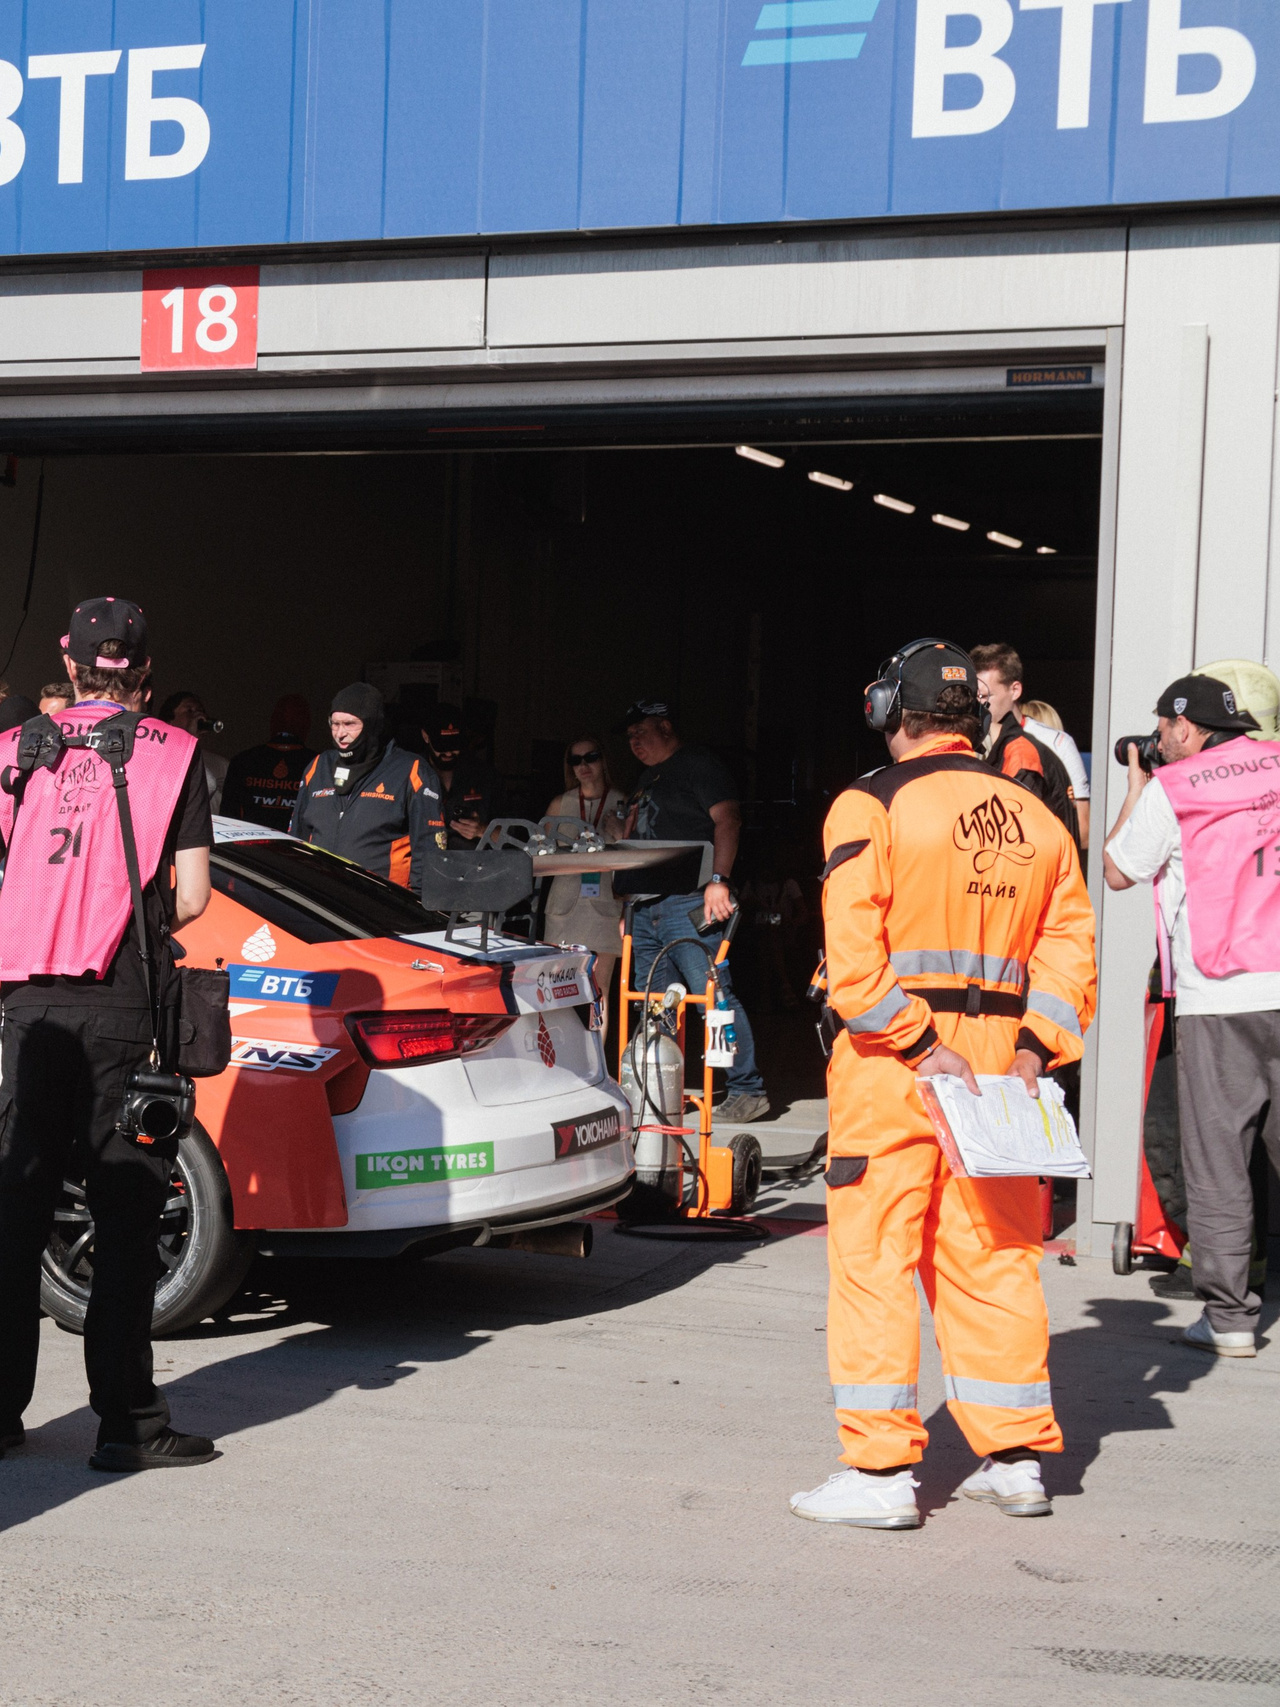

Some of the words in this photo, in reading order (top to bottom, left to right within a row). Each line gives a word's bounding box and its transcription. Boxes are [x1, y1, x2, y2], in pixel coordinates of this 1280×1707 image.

[911, 0, 1257, 138] ВТБ
[160, 284, 238, 354] 18
[941, 666, 968, 681] 222
[48, 822, 84, 864] 21
[261, 975, 314, 997] ВТБ
[575, 1115, 619, 1147] YOKOHAMA
[368, 1155, 424, 1172] IKON
[431, 1153, 487, 1170] TYRES
